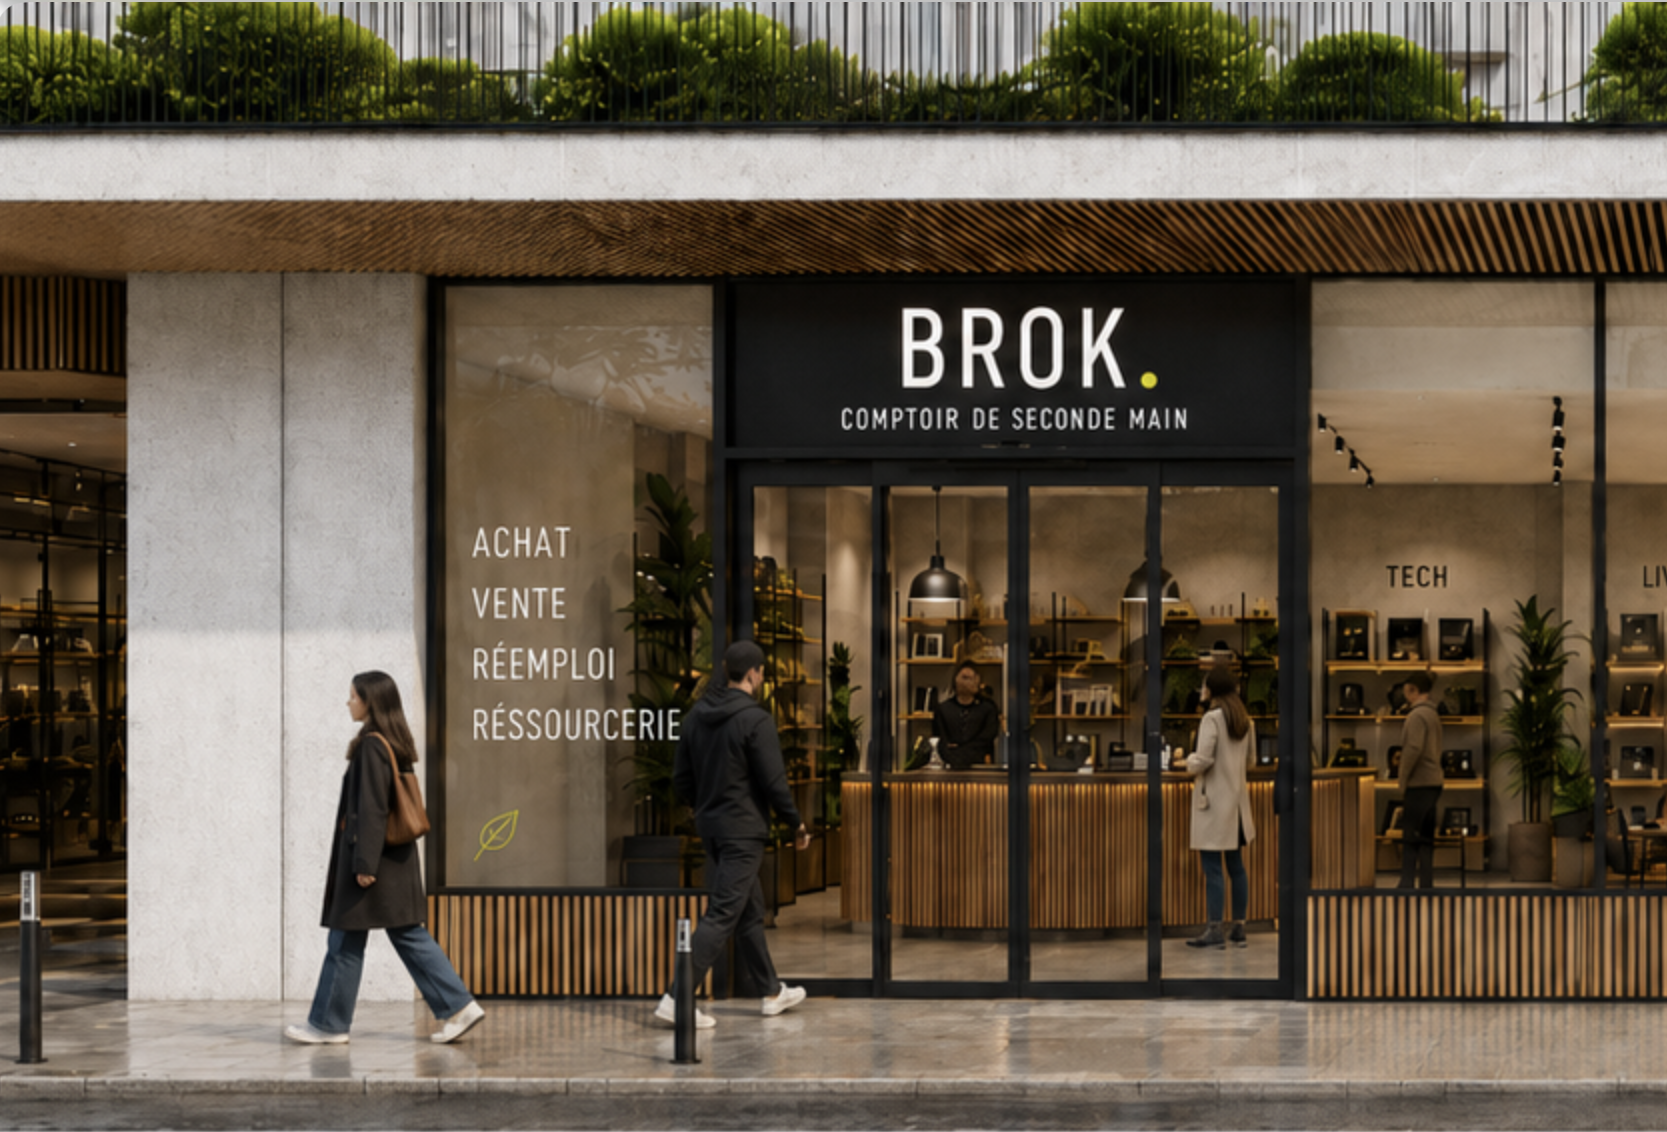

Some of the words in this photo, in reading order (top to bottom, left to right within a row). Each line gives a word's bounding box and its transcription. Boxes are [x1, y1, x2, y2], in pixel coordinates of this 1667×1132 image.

[901, 306, 1158, 390] BROK.
[841, 407, 959, 431] COMPTOIR
[972, 407, 1000, 431] DE
[1011, 407, 1116, 431] SECONDE
[1129, 407, 1188, 431] MAIN
[472, 526, 571, 558] ACHAT
[1386, 565, 1448, 588] TECH
[472, 587, 566, 619] VENTE
[473, 641, 615, 681] RÉEMPLOI
[473, 702, 681, 741] RÉSSOURCERIE
